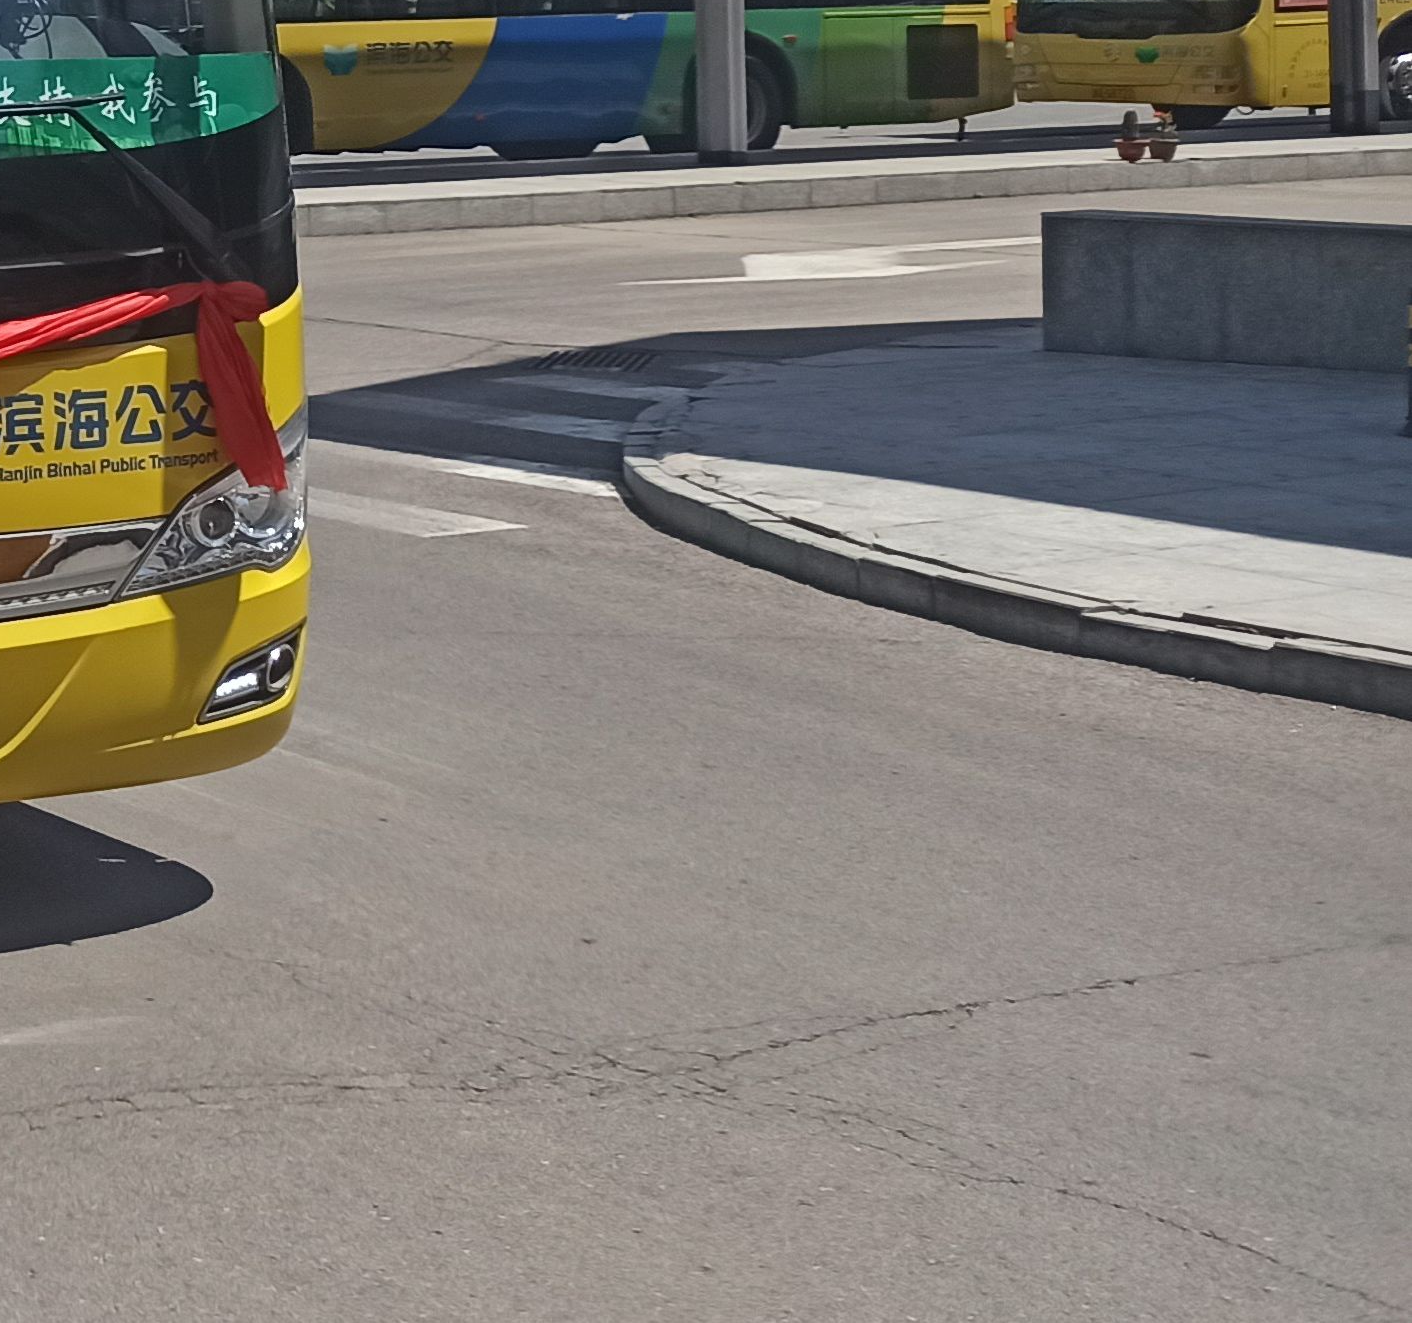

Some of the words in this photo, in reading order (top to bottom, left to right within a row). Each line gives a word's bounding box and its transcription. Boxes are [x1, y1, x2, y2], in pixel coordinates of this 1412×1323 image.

[47, 461, 96, 478] Binhai
[100, 457, 146, 474] Public
[149, 448, 219, 470] Transport
